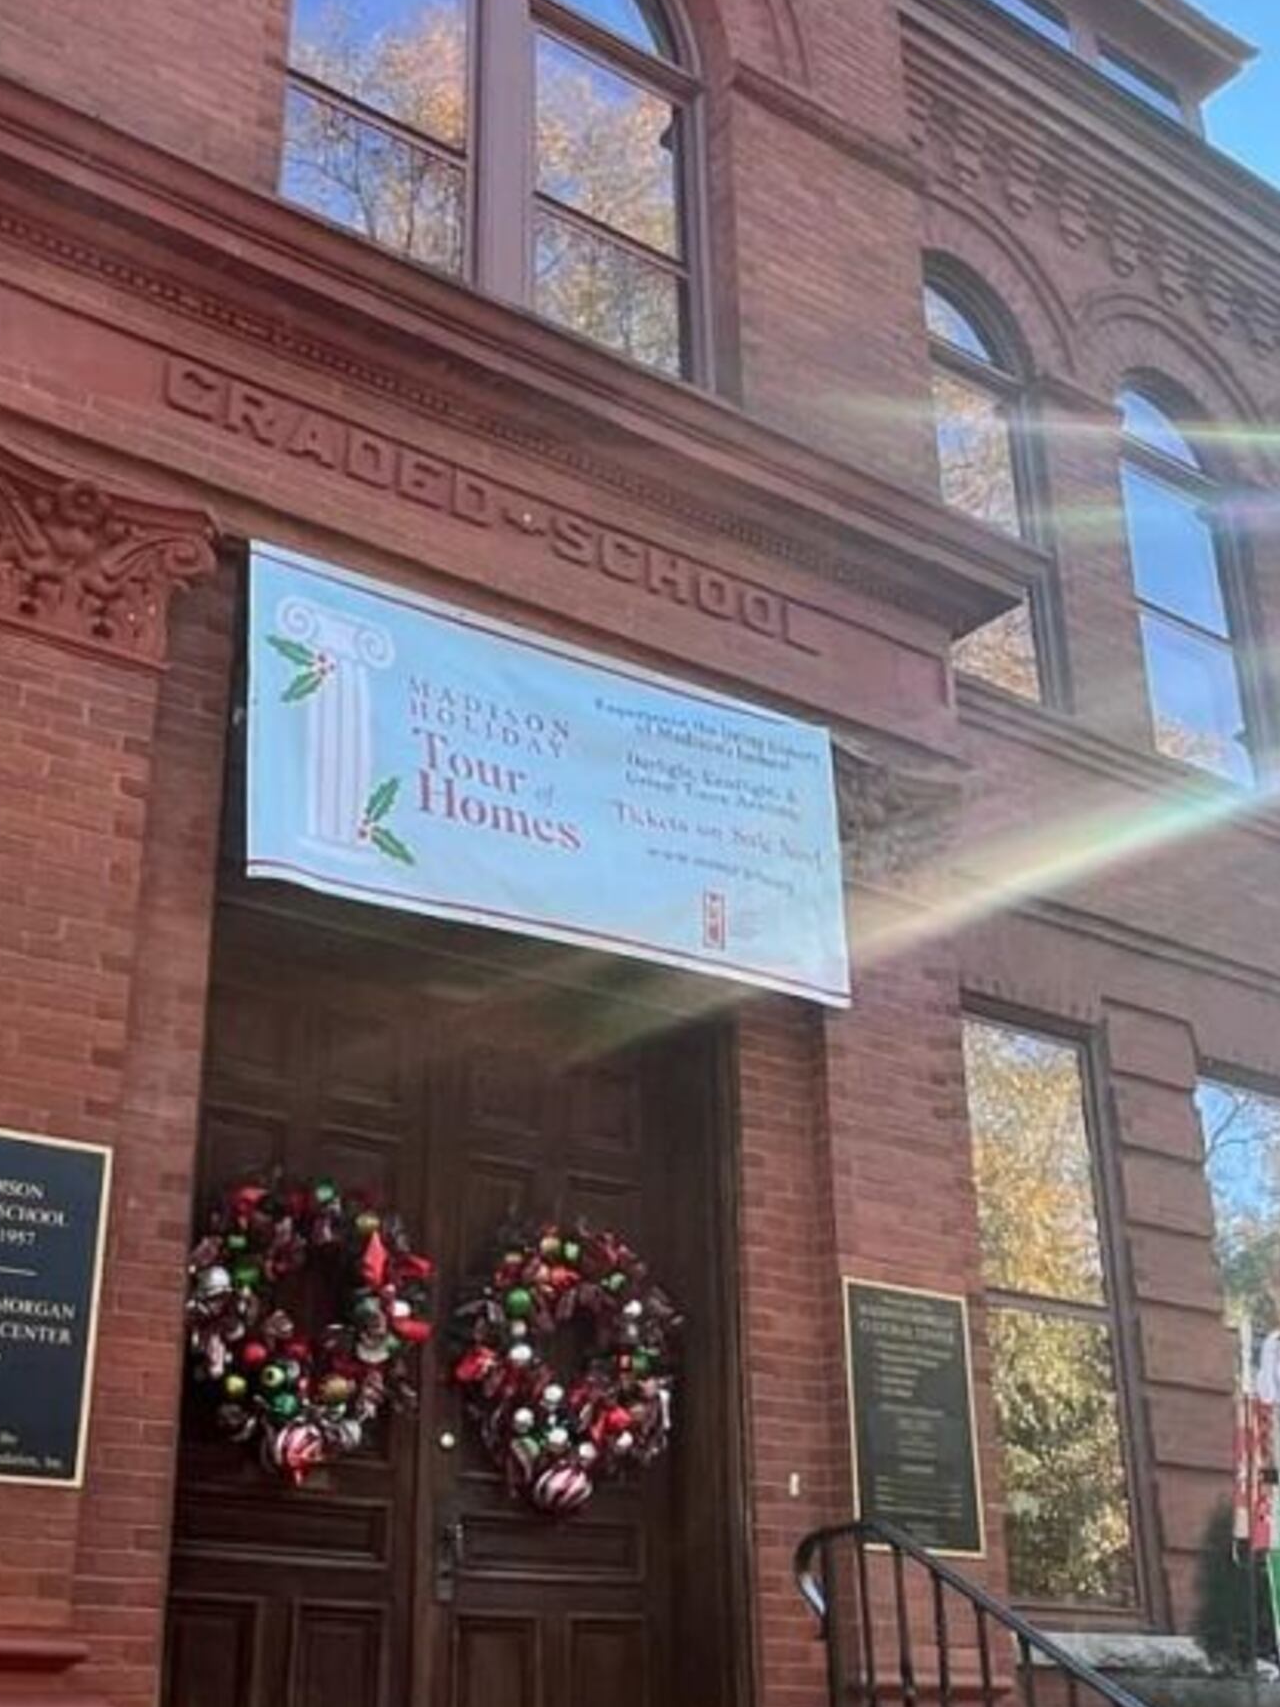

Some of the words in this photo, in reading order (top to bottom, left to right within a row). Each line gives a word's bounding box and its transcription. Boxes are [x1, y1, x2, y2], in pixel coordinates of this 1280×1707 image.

[162, 355, 494, 529] GRADED
[549, 515, 822, 658] SCHOOL
[409, 675, 570, 740] MADISON
[409, 697, 563, 759] HOLIDAY
[411, 726, 528, 794] Tour
[418, 768, 582, 850] Homes
